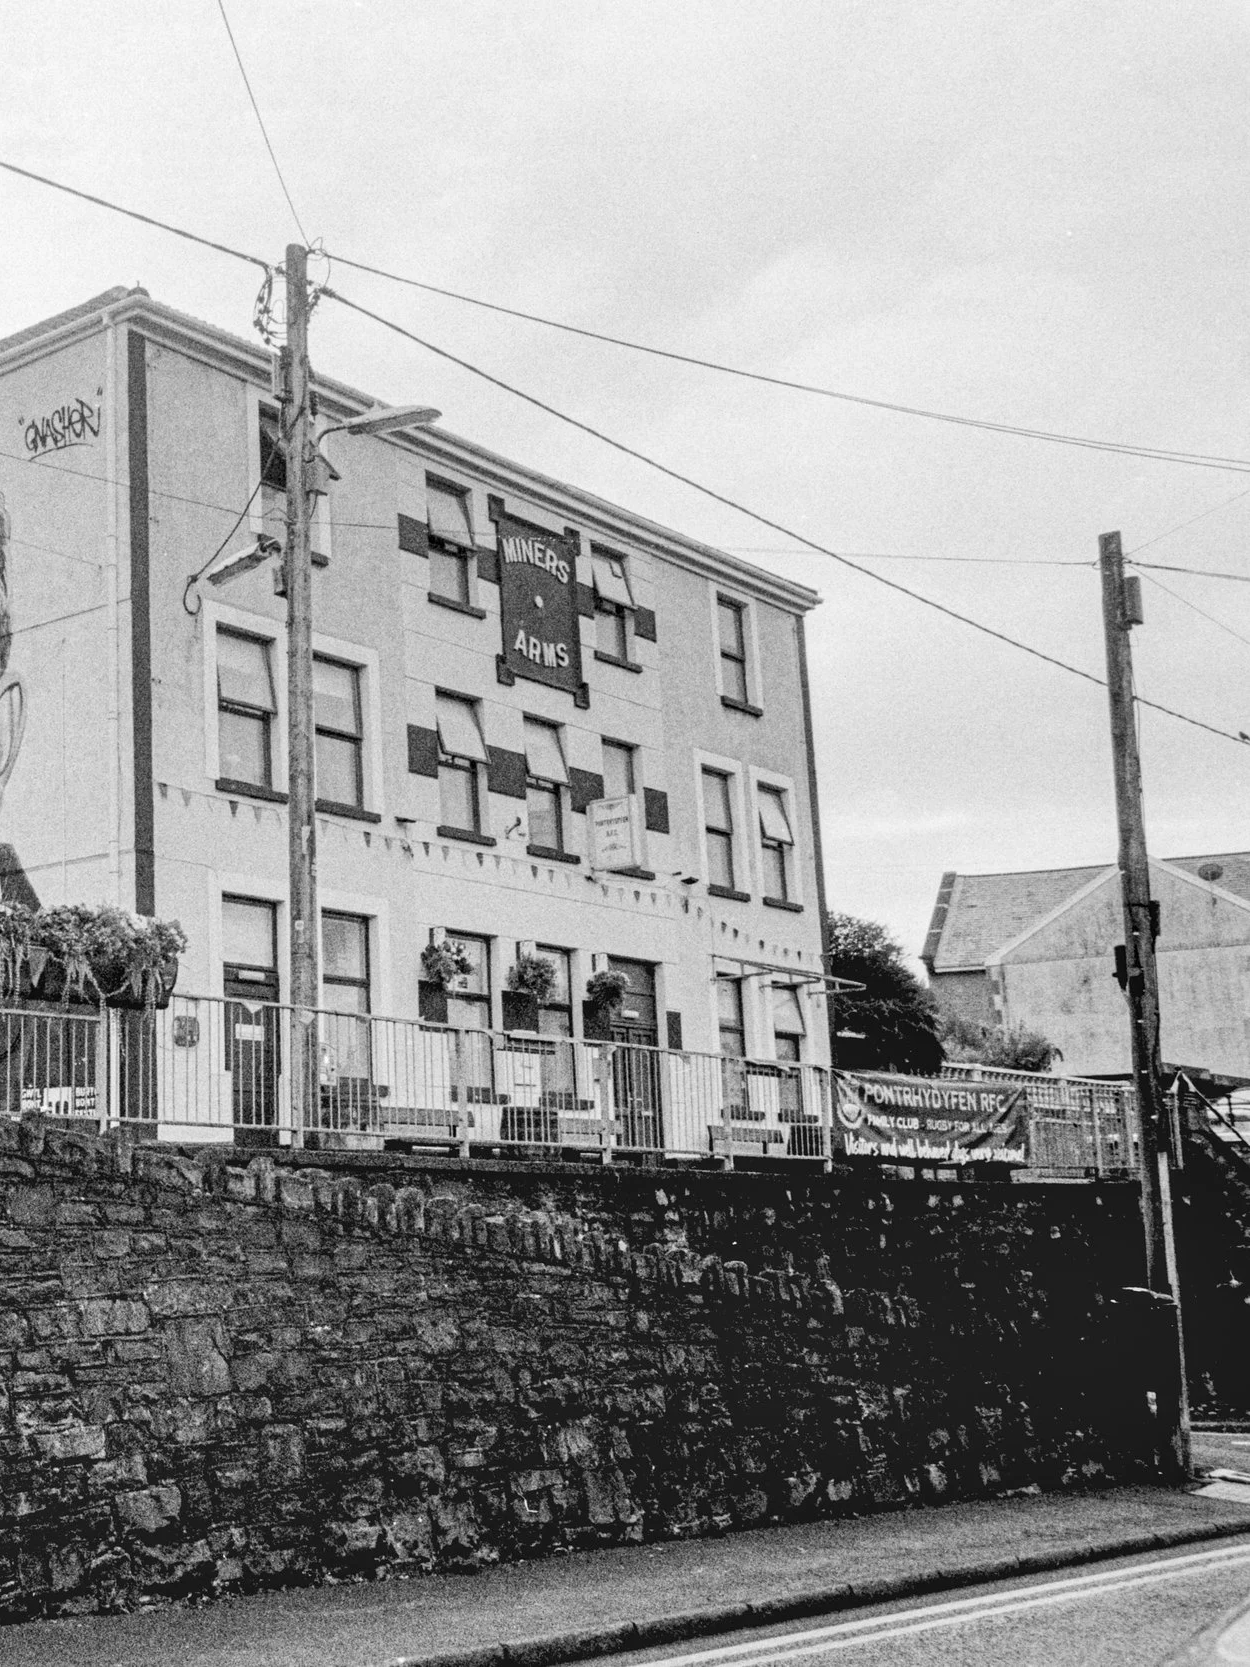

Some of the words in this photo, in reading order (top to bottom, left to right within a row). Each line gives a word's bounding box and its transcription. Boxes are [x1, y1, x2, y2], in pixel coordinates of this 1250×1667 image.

[503, 537, 570, 584] MINERS
[514, 629, 569, 667] ARMS
[864, 1084, 977, 1111] PONTRHYDYFEN
[980, 1093, 1007, 1112] RFC
[867, 1114, 895, 1128] FAMILY
[896, 1116, 919, 1130] CLUB
[926, 1118, 952, 1131] RUGBY
[953, 1120, 971, 1132] FOR
